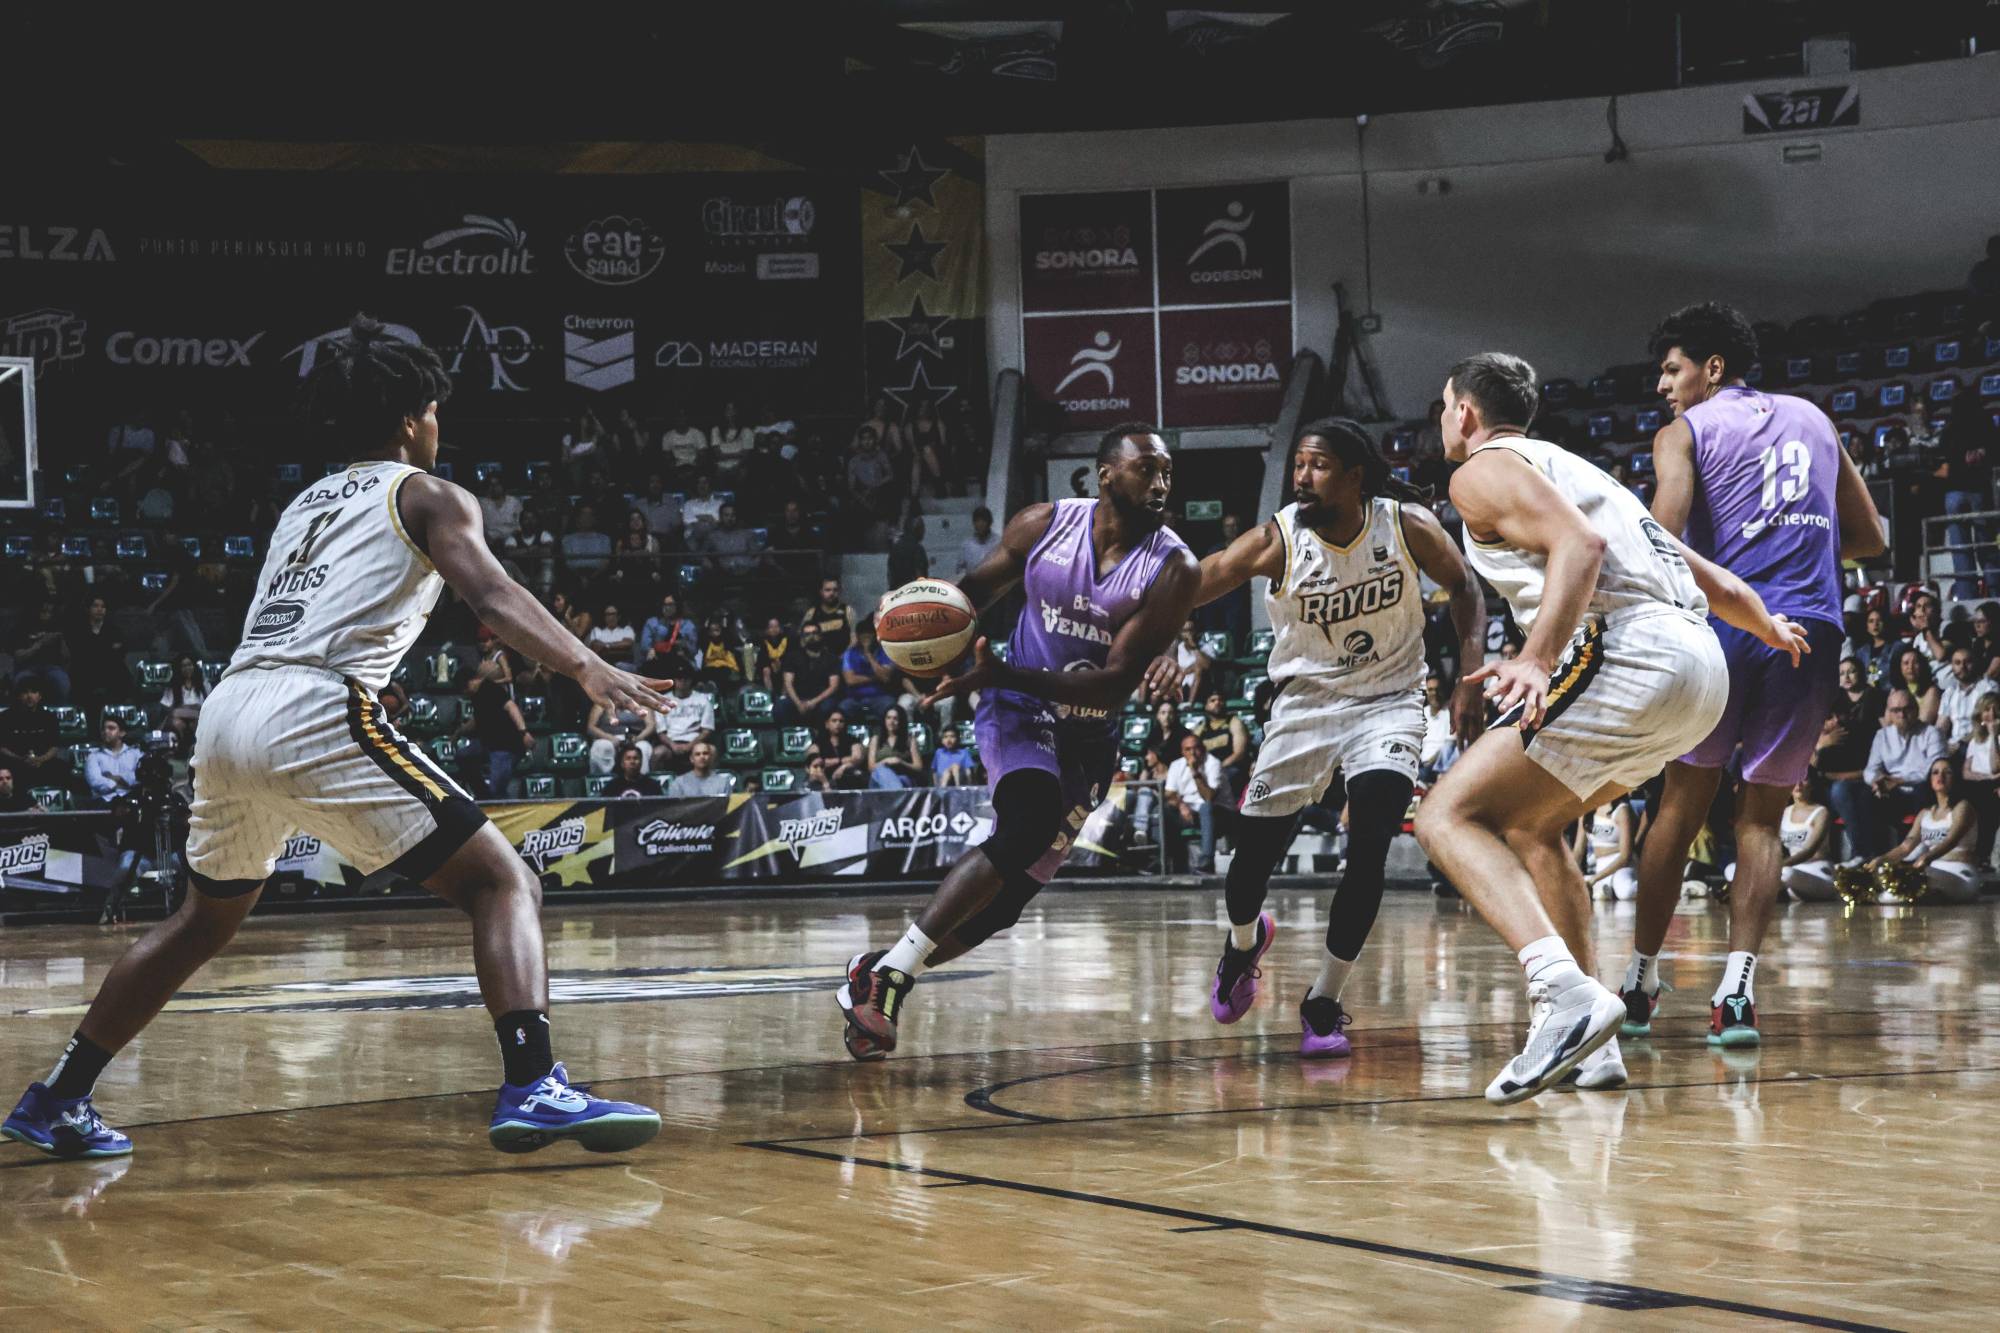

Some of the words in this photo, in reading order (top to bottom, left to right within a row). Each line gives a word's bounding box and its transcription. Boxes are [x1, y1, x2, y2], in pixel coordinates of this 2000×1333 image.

[1777, 96, 1822, 125] 201
[385, 248, 536, 276] Electrolit
[586, 257, 641, 277] salad
[1035, 248, 1139, 269] SONORA
[563, 315, 635, 330] Chevron
[105, 330, 267, 368] Comex
[709, 340, 818, 358] MADERAN
[1175, 362, 1281, 385] SONORA
[1759, 440, 1813, 511] 13
[1300, 569, 1405, 626] RAYOS
[523, 822, 585, 856] RAYOS
[637, 819, 716, 845] Caliente
[777, 817, 842, 845] RAYOS
[880, 812, 949, 840] ARCO
[657, 843, 713, 854] caliente.mx
